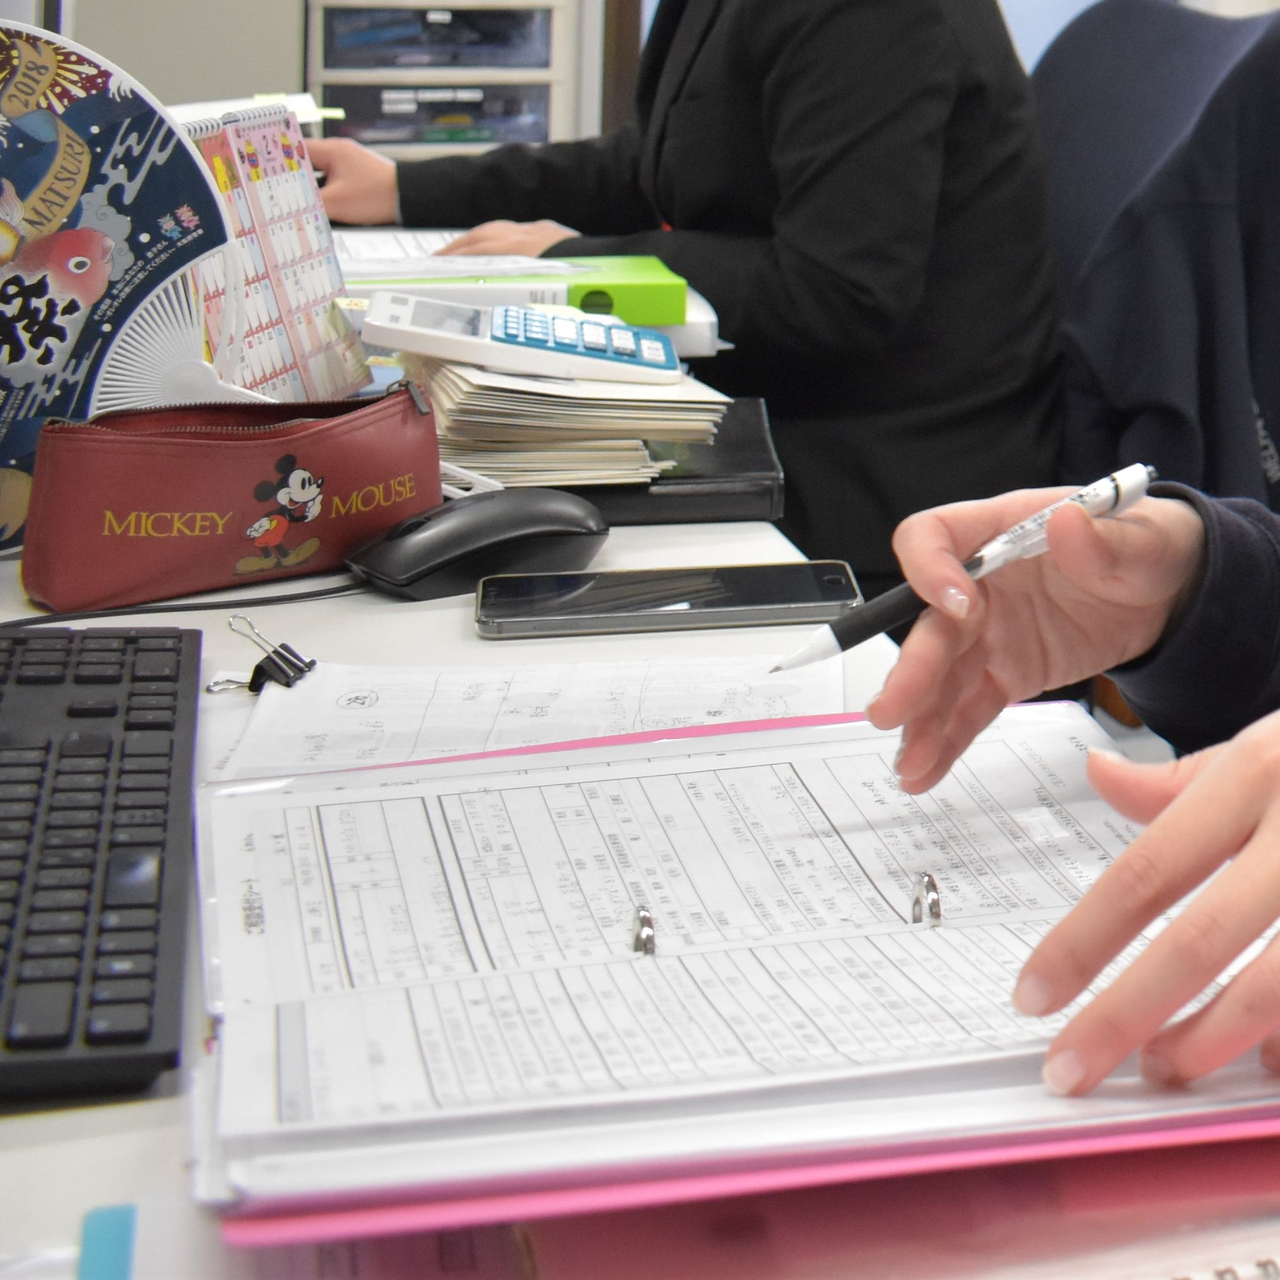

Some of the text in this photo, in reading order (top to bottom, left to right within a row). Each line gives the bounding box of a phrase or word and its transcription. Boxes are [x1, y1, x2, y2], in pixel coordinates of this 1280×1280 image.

[8, 59, 50, 109] 2018
[23, 132, 88, 234] MATSURI
[101, 472, 417, 539] MICKEY MOUSE
